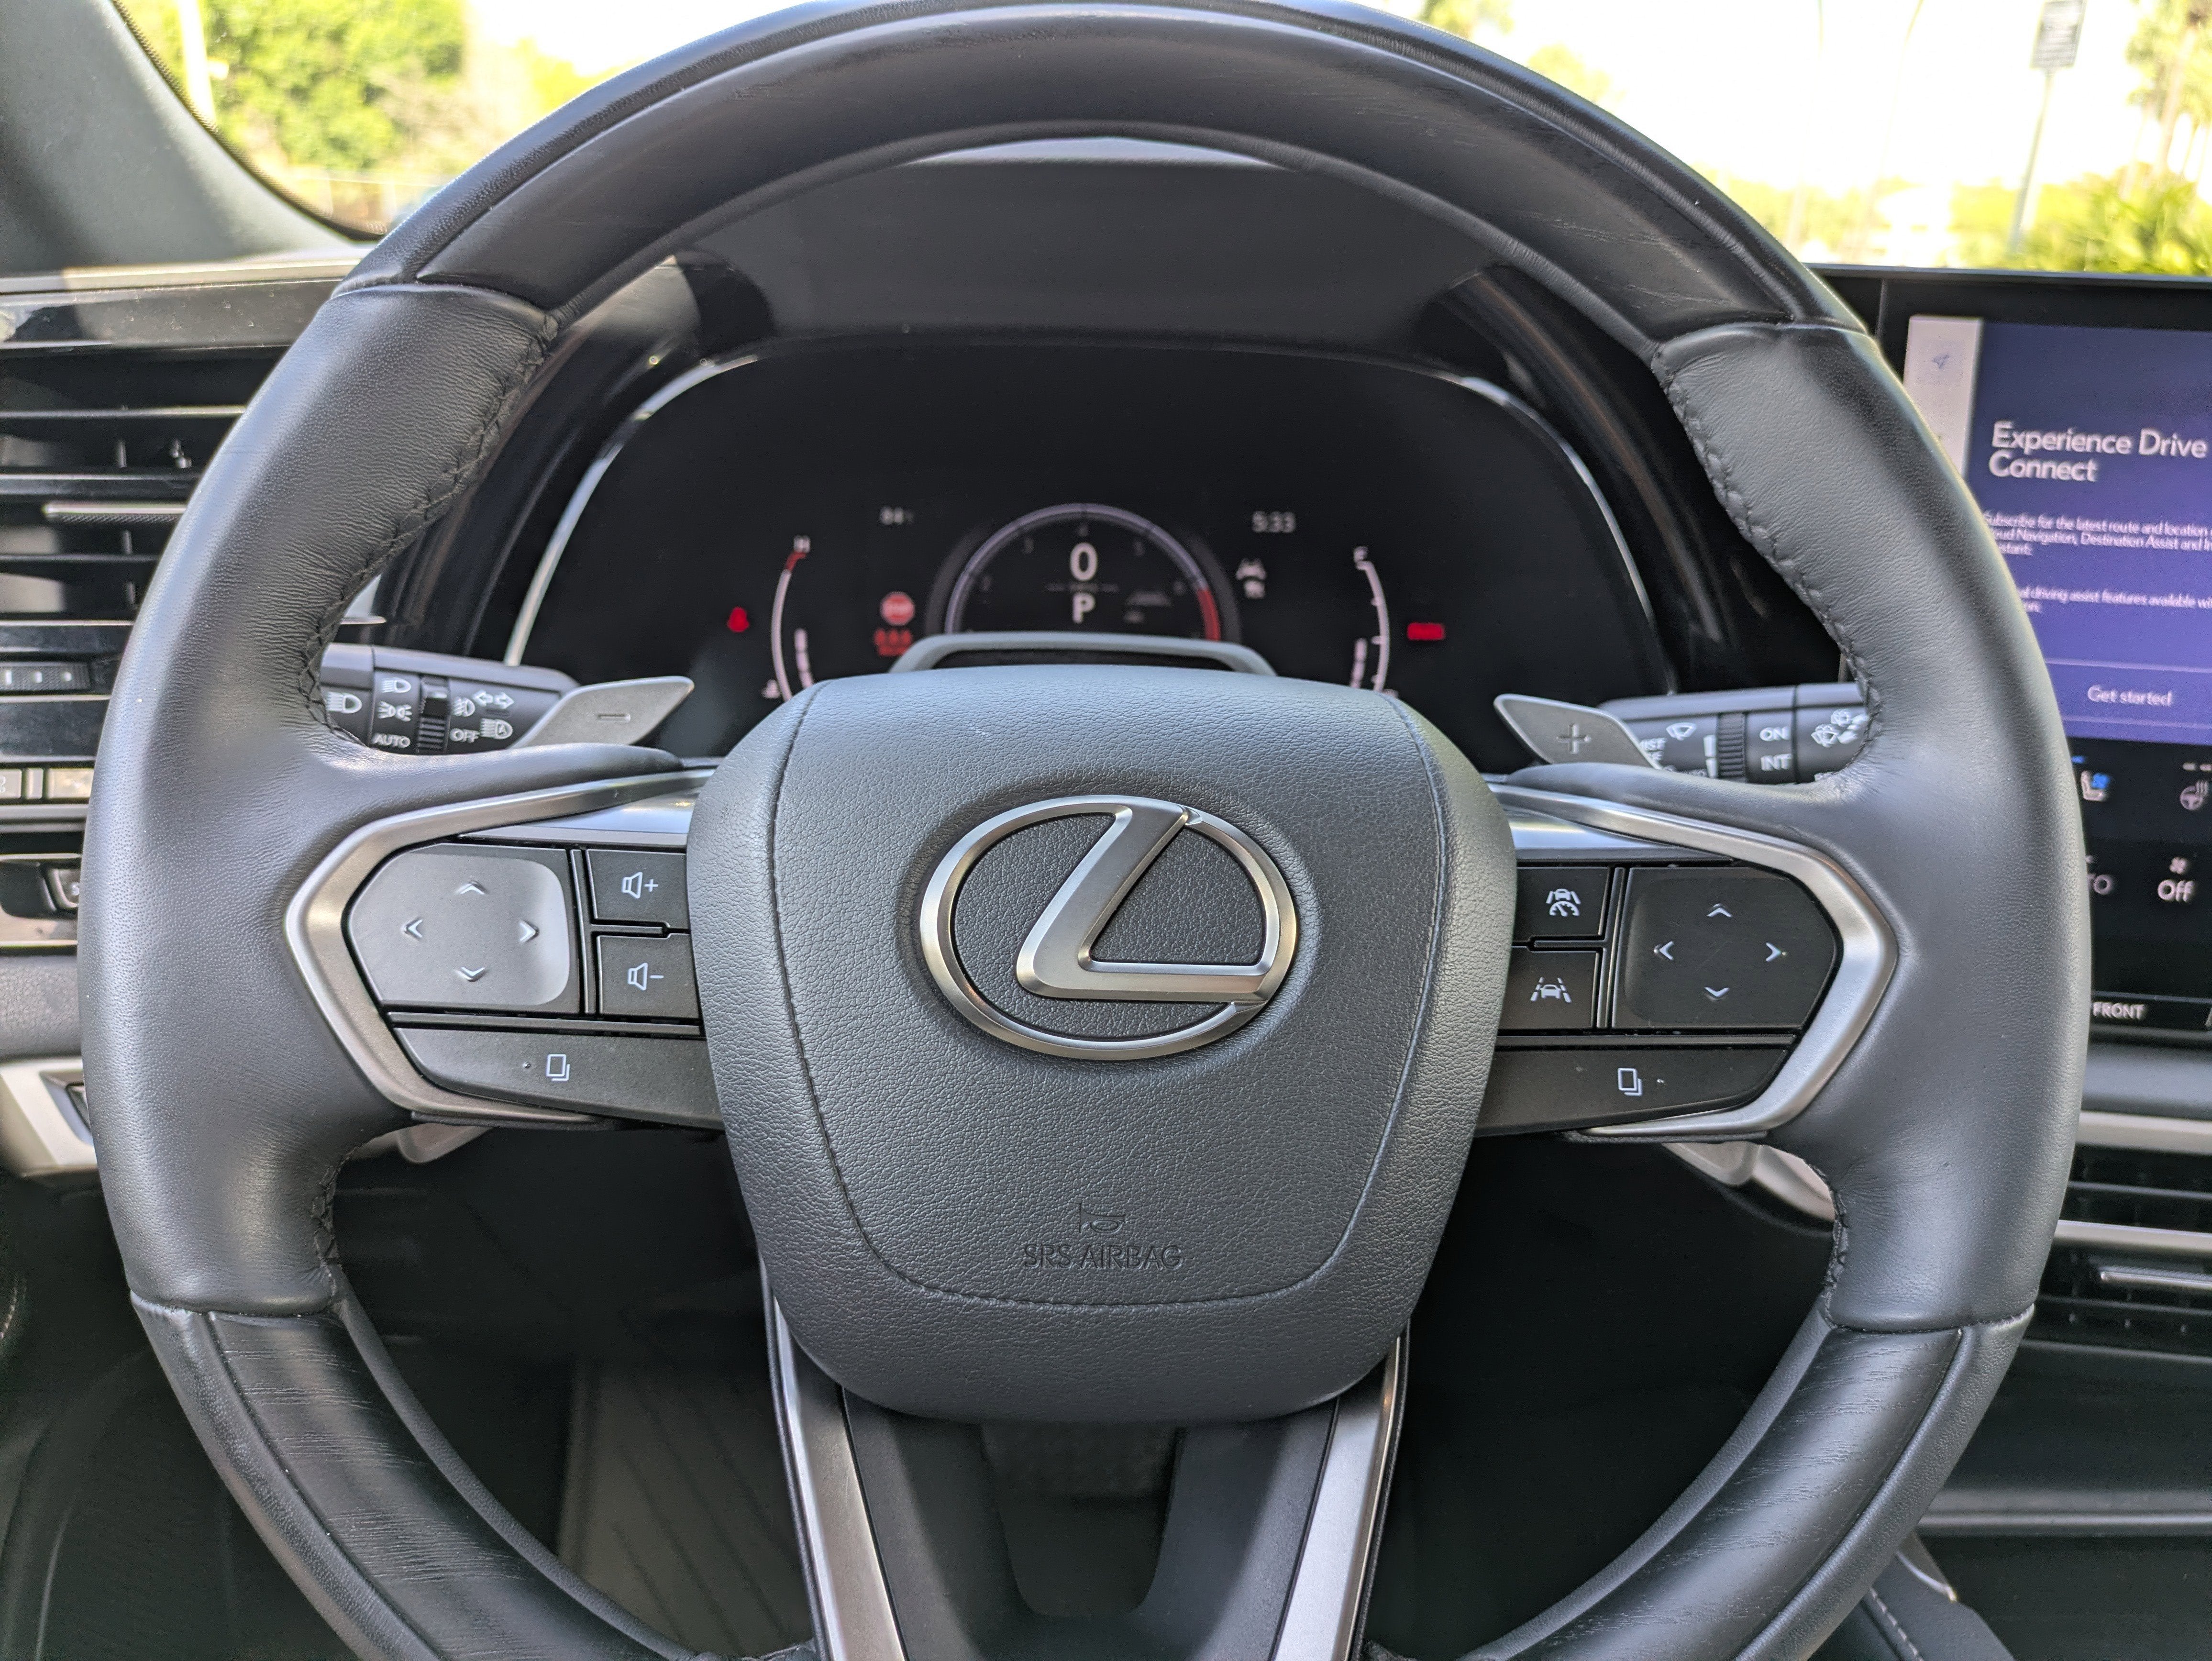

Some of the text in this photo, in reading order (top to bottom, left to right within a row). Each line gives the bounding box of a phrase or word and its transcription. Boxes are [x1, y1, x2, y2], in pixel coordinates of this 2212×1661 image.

[1991, 420, 2207, 459] Experience Drive
[1989, 450, 2099, 482] Connect
[2037, 513, 2056, 529] for
[2057, 515, 2075, 530] the
[2076, 516, 2107, 532] latest
[2108, 521, 2140, 534] route
[2141, 520, 2163, 535] and
[2164, 520, 2208, 537] location
[2080, 532, 2145, 548] Destination
[2145, 534, 2179, 550] Assist
[2180, 537, 2202, 551] and
[1069, 542, 1098, 581] 0
[1073, 592, 1095, 623] P
[2030, 586, 2068, 604] driving
[2069, 590, 2101, 603] assist
[2102, 589, 2147, 606] features
[2148, 593, 2196, 609] available
[2087, 684, 2173, 707] Get started
[371, 732, 411, 749] AUTO
[449, 728, 480, 743] OFF
[1759, 726, 1790, 742] ON
[1760, 753, 1793, 771] INT
[2157, 879, 2196, 902] Off
[2092, 1001, 2147, 1020] FRONT
[1023, 1244, 1184, 1271] SRS AIRBAG
